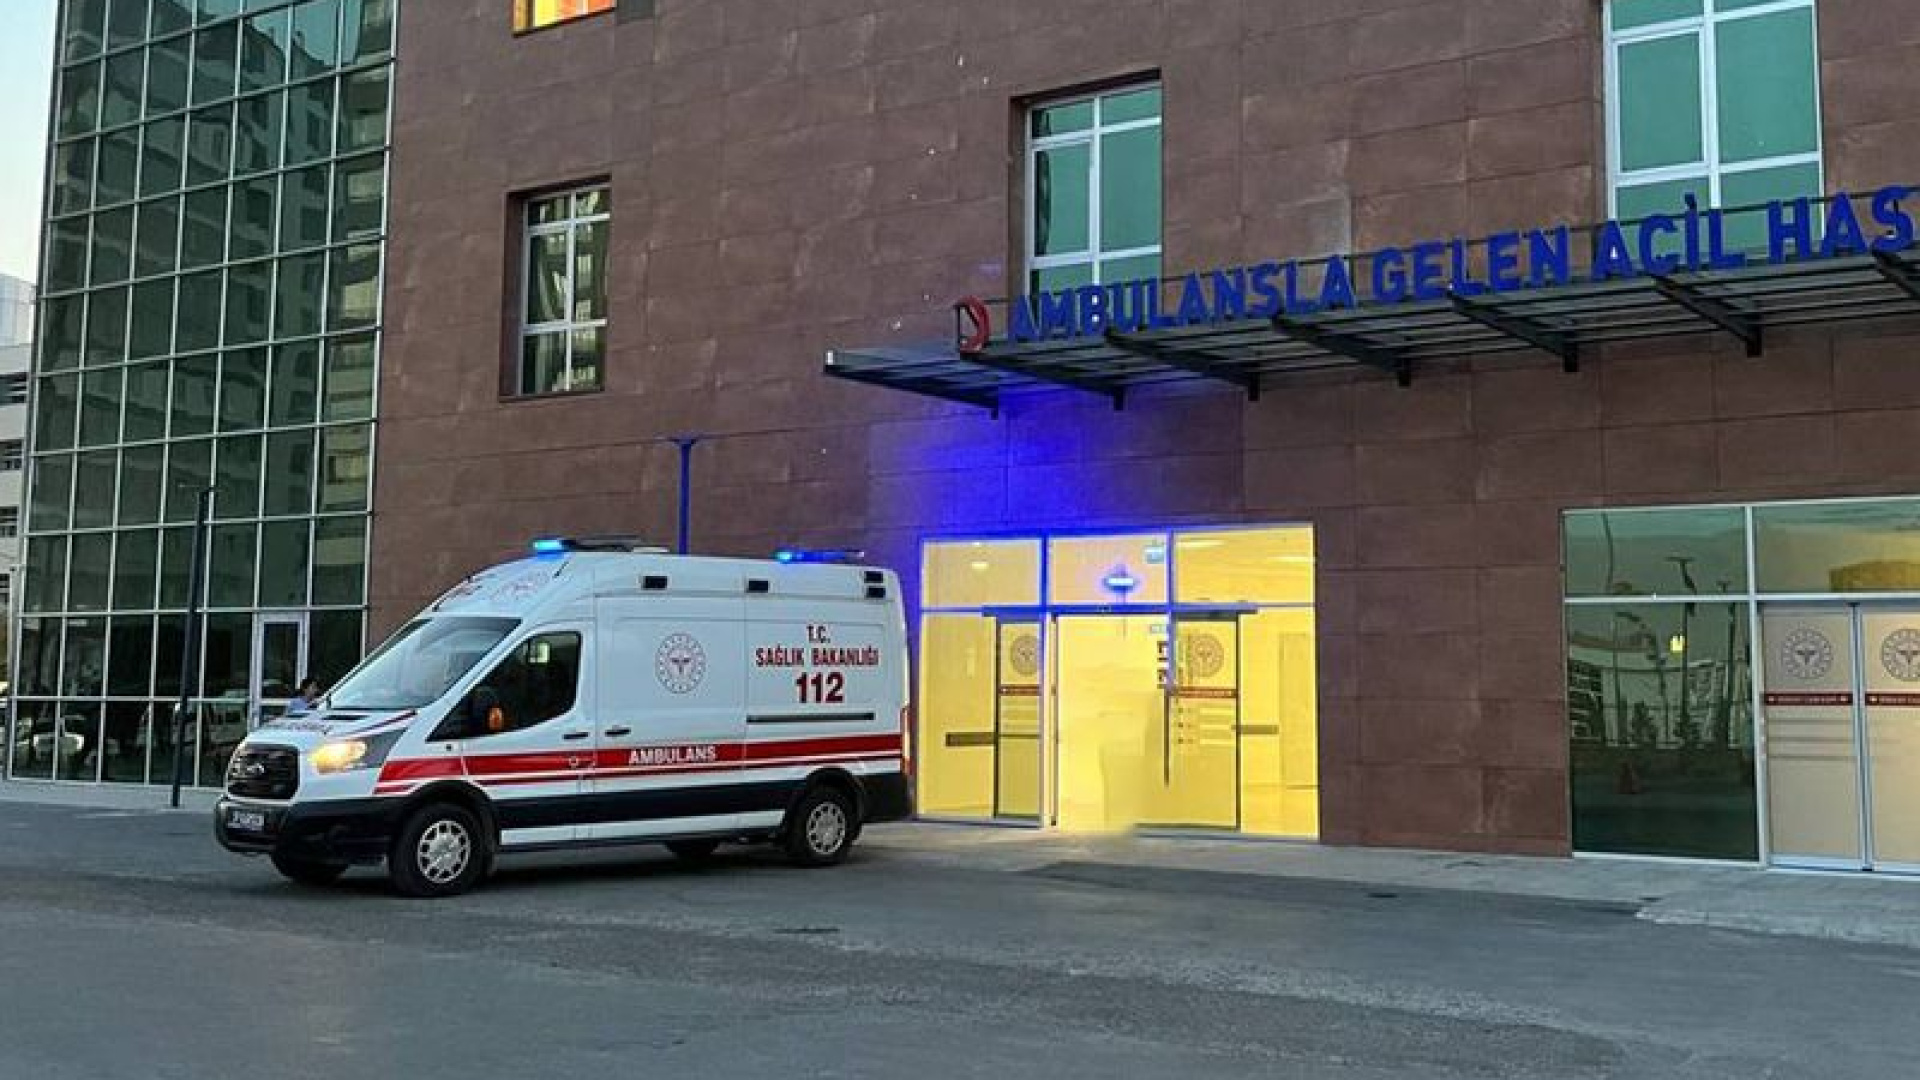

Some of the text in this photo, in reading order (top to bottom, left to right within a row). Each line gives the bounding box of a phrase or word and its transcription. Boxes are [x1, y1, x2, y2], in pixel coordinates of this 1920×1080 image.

[1008, 185, 1914, 342] AMBULANSLA GELEN ACİL HAS
[755, 643, 879, 667] SAĞLIK BAKANLIĞI
[795, 671, 844, 703] 112
[628, 745, 716, 765] AMBULANS
